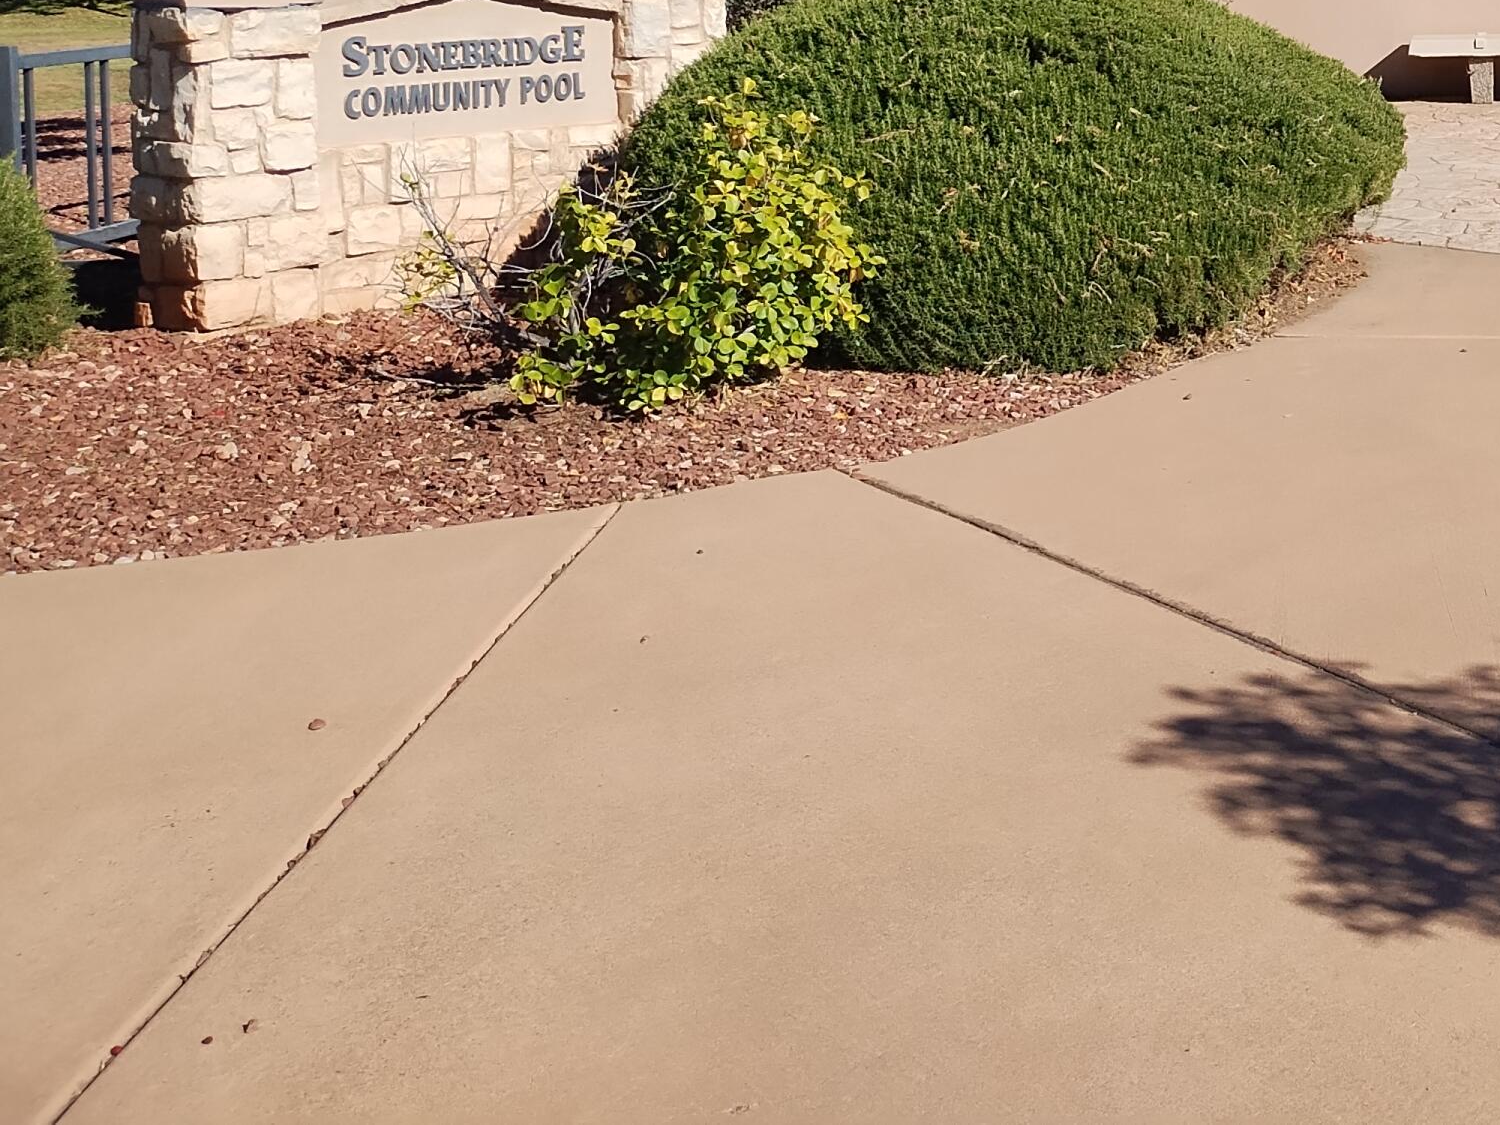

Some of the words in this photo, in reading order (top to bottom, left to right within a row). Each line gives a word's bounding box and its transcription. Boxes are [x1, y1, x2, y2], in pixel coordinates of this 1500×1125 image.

[341, 25, 586, 77] STONEBRIDGE
[343, 77, 512, 120] COMMUNITY
[519, 72, 586, 106] POOL
